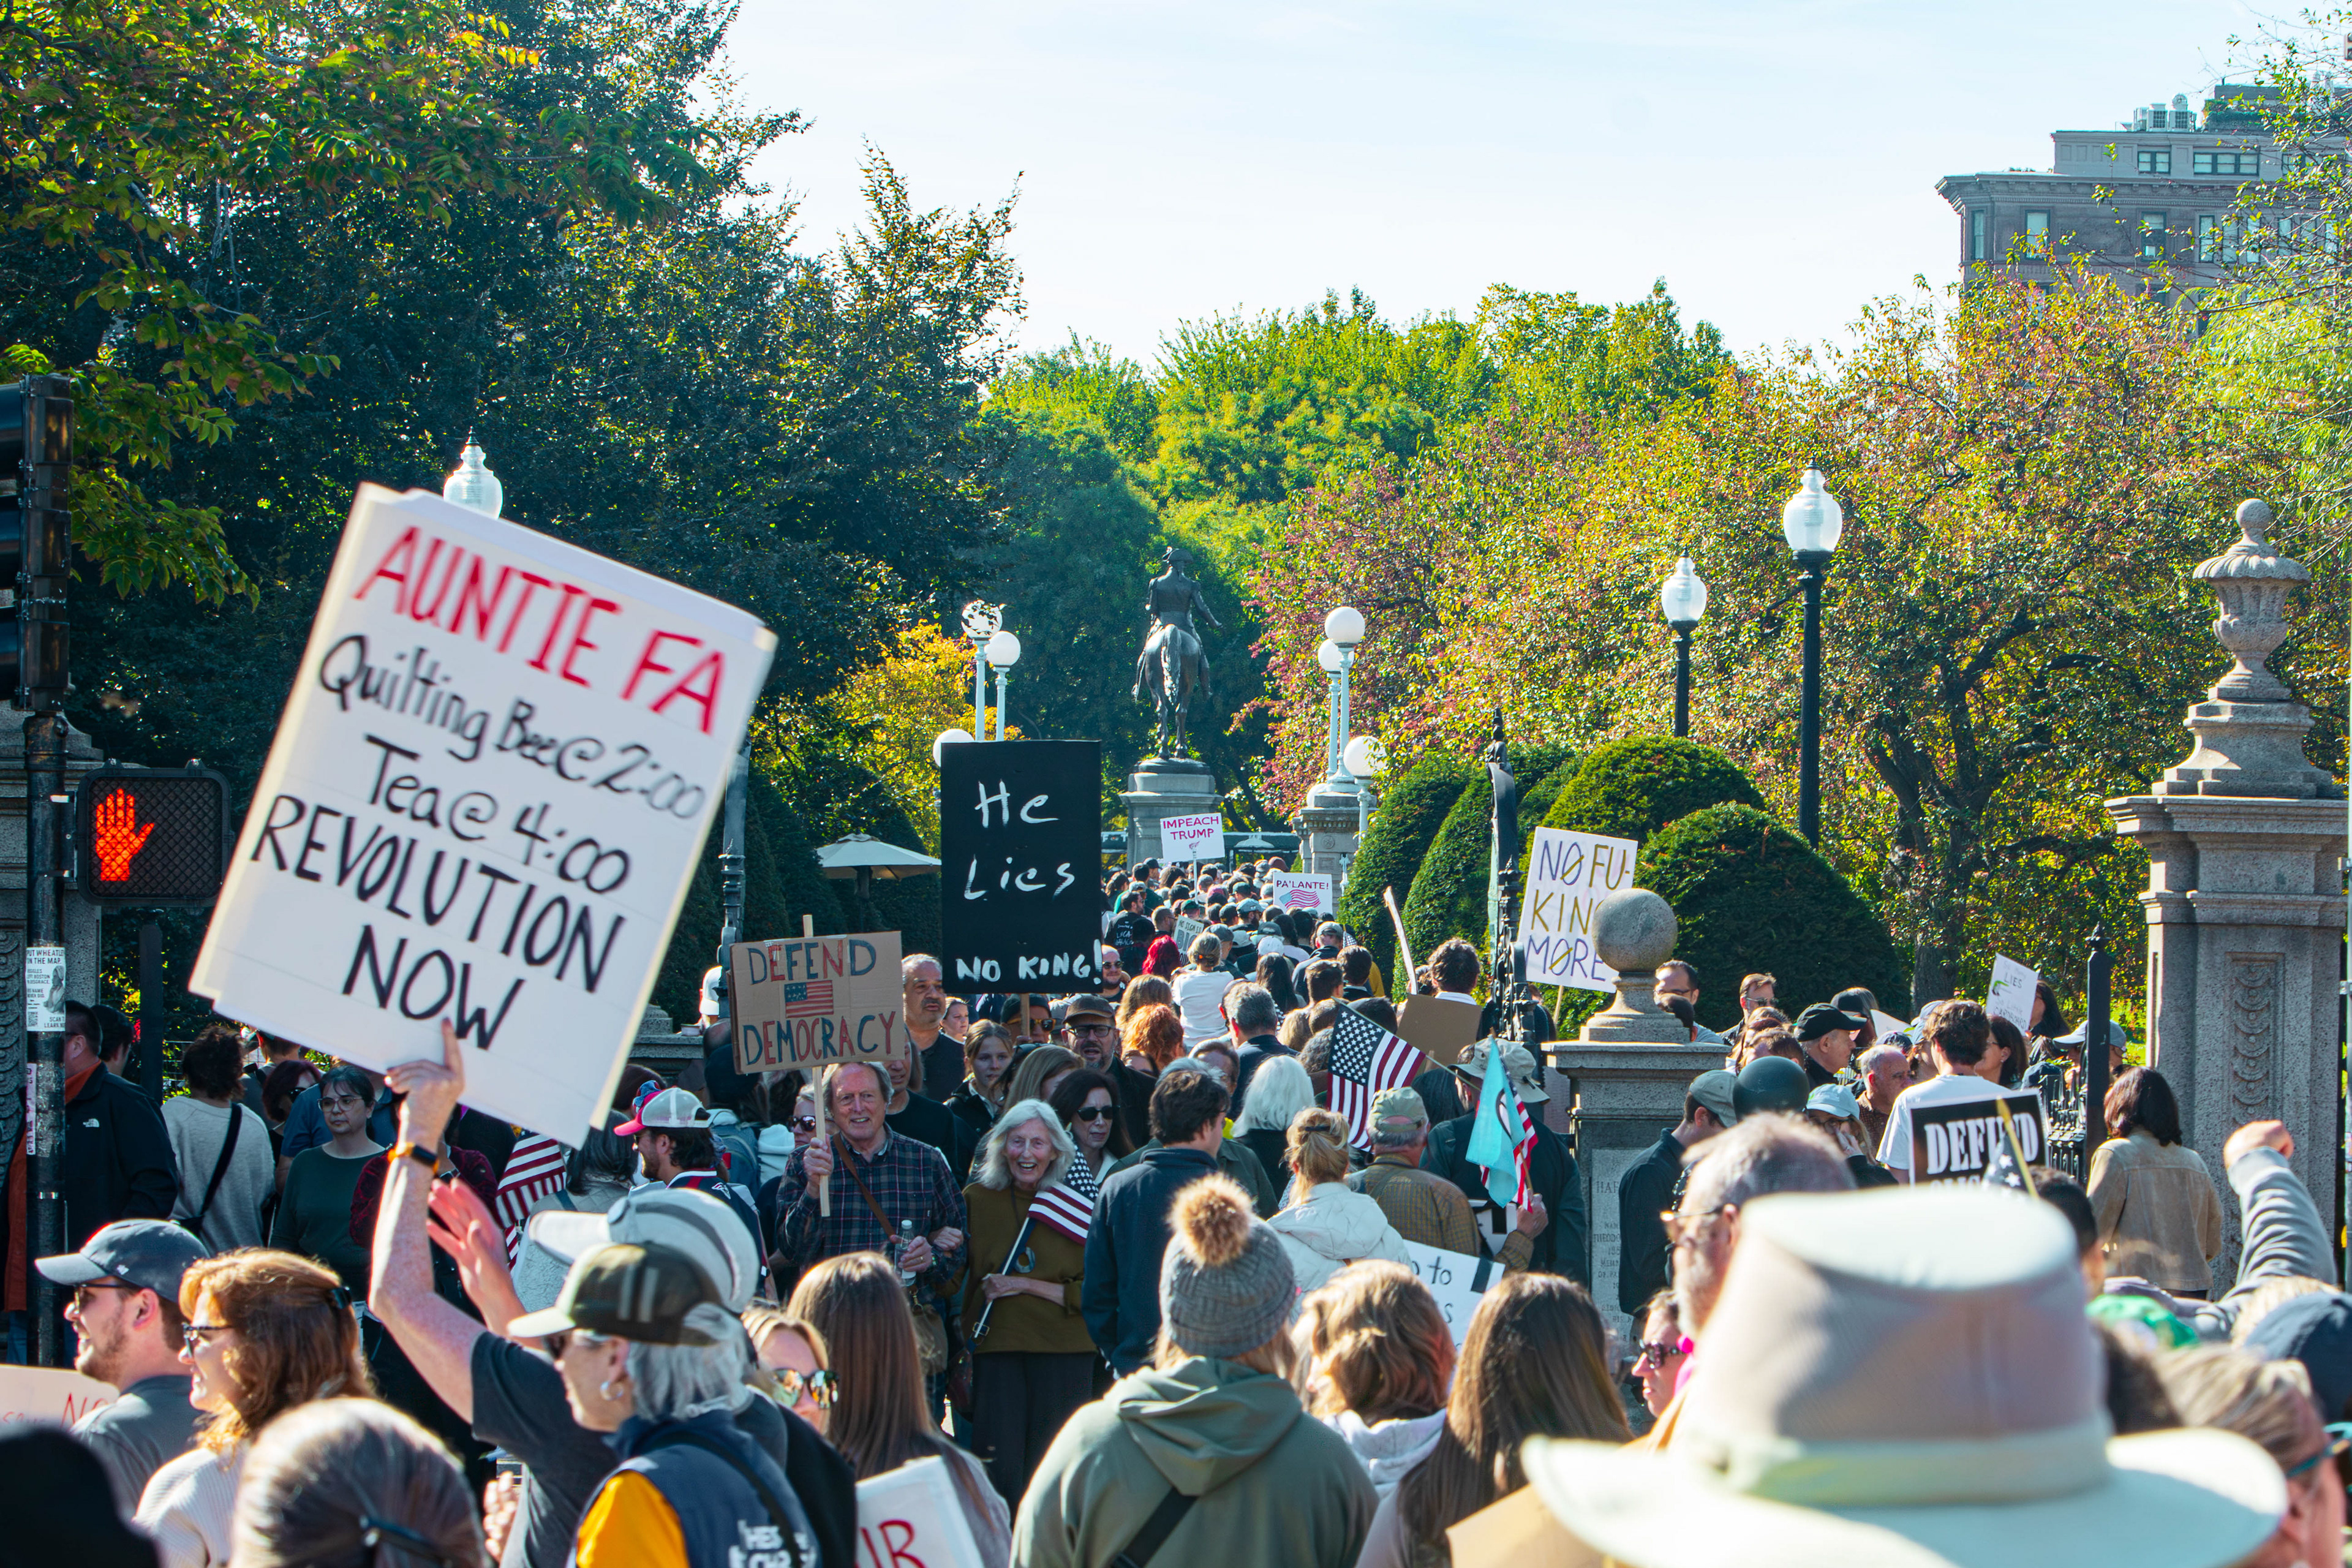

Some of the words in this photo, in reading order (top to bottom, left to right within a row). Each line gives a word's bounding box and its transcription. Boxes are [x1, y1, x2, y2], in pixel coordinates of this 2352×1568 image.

[355, 527, 621, 687] AUNTIE
[621, 630, 726, 734] FA
[320, 635, 490, 762] Quilting
[974, 780, 1060, 828] He
[1163, 816, 1219, 829] IMPEACH
[1170, 829, 1214, 840] TRUMP
[251, 794, 625, 993] REVOLUTION
[964, 855, 1075, 900] Lies
[1276, 880, 1329, 889] PA'LANTE!
[1531, 889, 1605, 935] KIN
[747, 939, 876, 985] DEFEND
[957, 957, 1001, 983] NO
[2003, 972, 2022, 989] LIES
[342, 924, 525, 1050] NOW
[742, 1011, 896, 1065] DEMOCRACY
[1427, 1256, 1452, 1285] to
